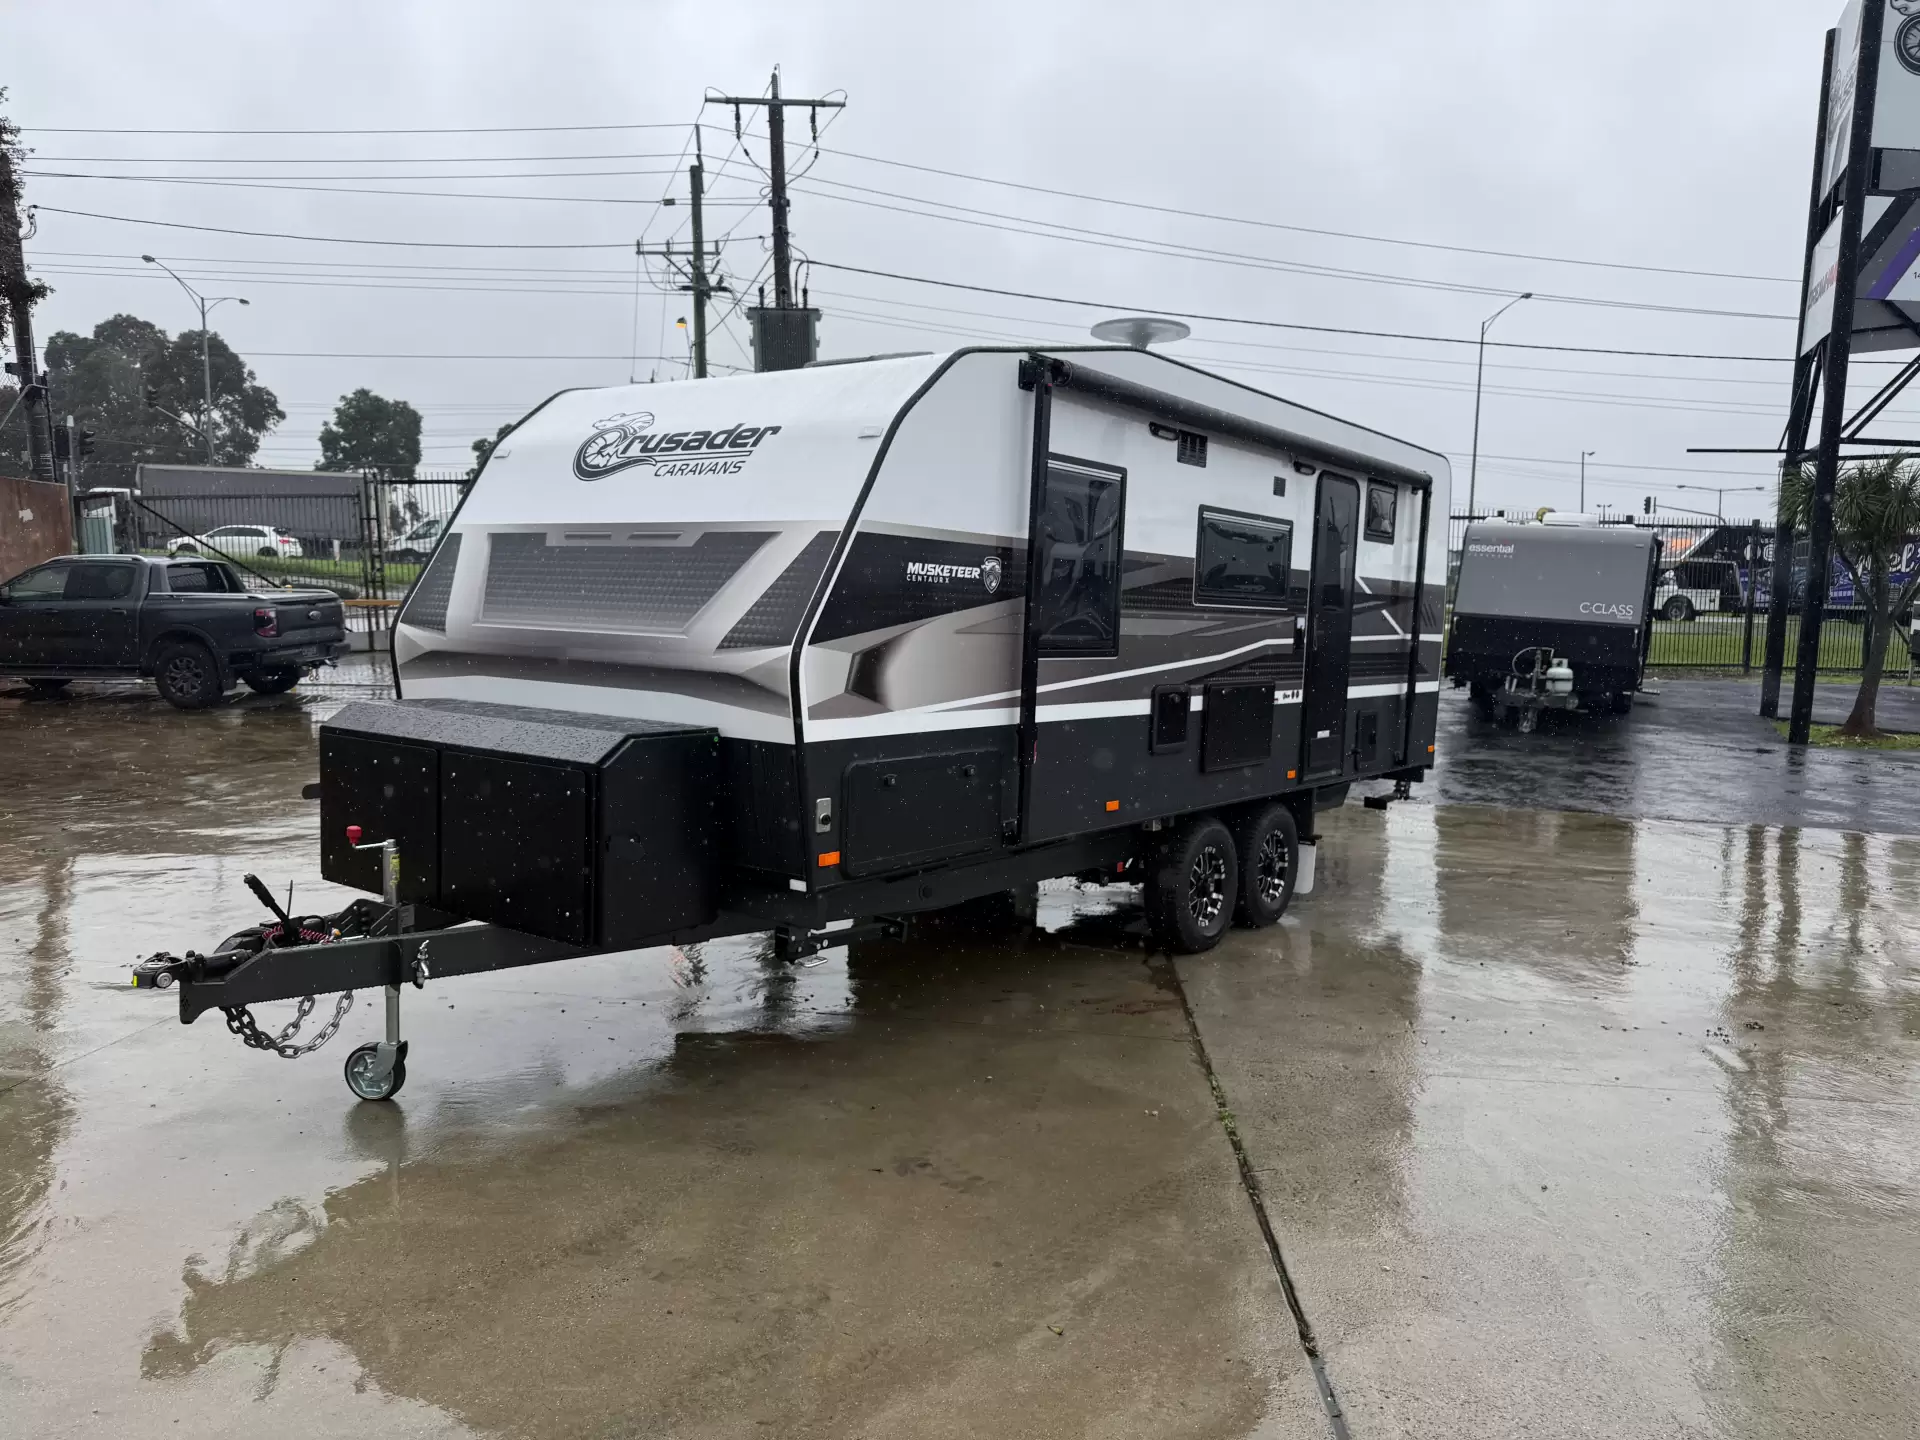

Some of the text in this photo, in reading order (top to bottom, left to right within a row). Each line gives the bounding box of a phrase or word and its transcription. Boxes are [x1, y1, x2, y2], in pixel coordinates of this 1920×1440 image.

[573, 413, 782, 482] Crusader
[654, 460, 746, 477] CARAVANS
[1469, 543, 1514, 554] essential
[907, 562, 981, 579] MUSKETEER
